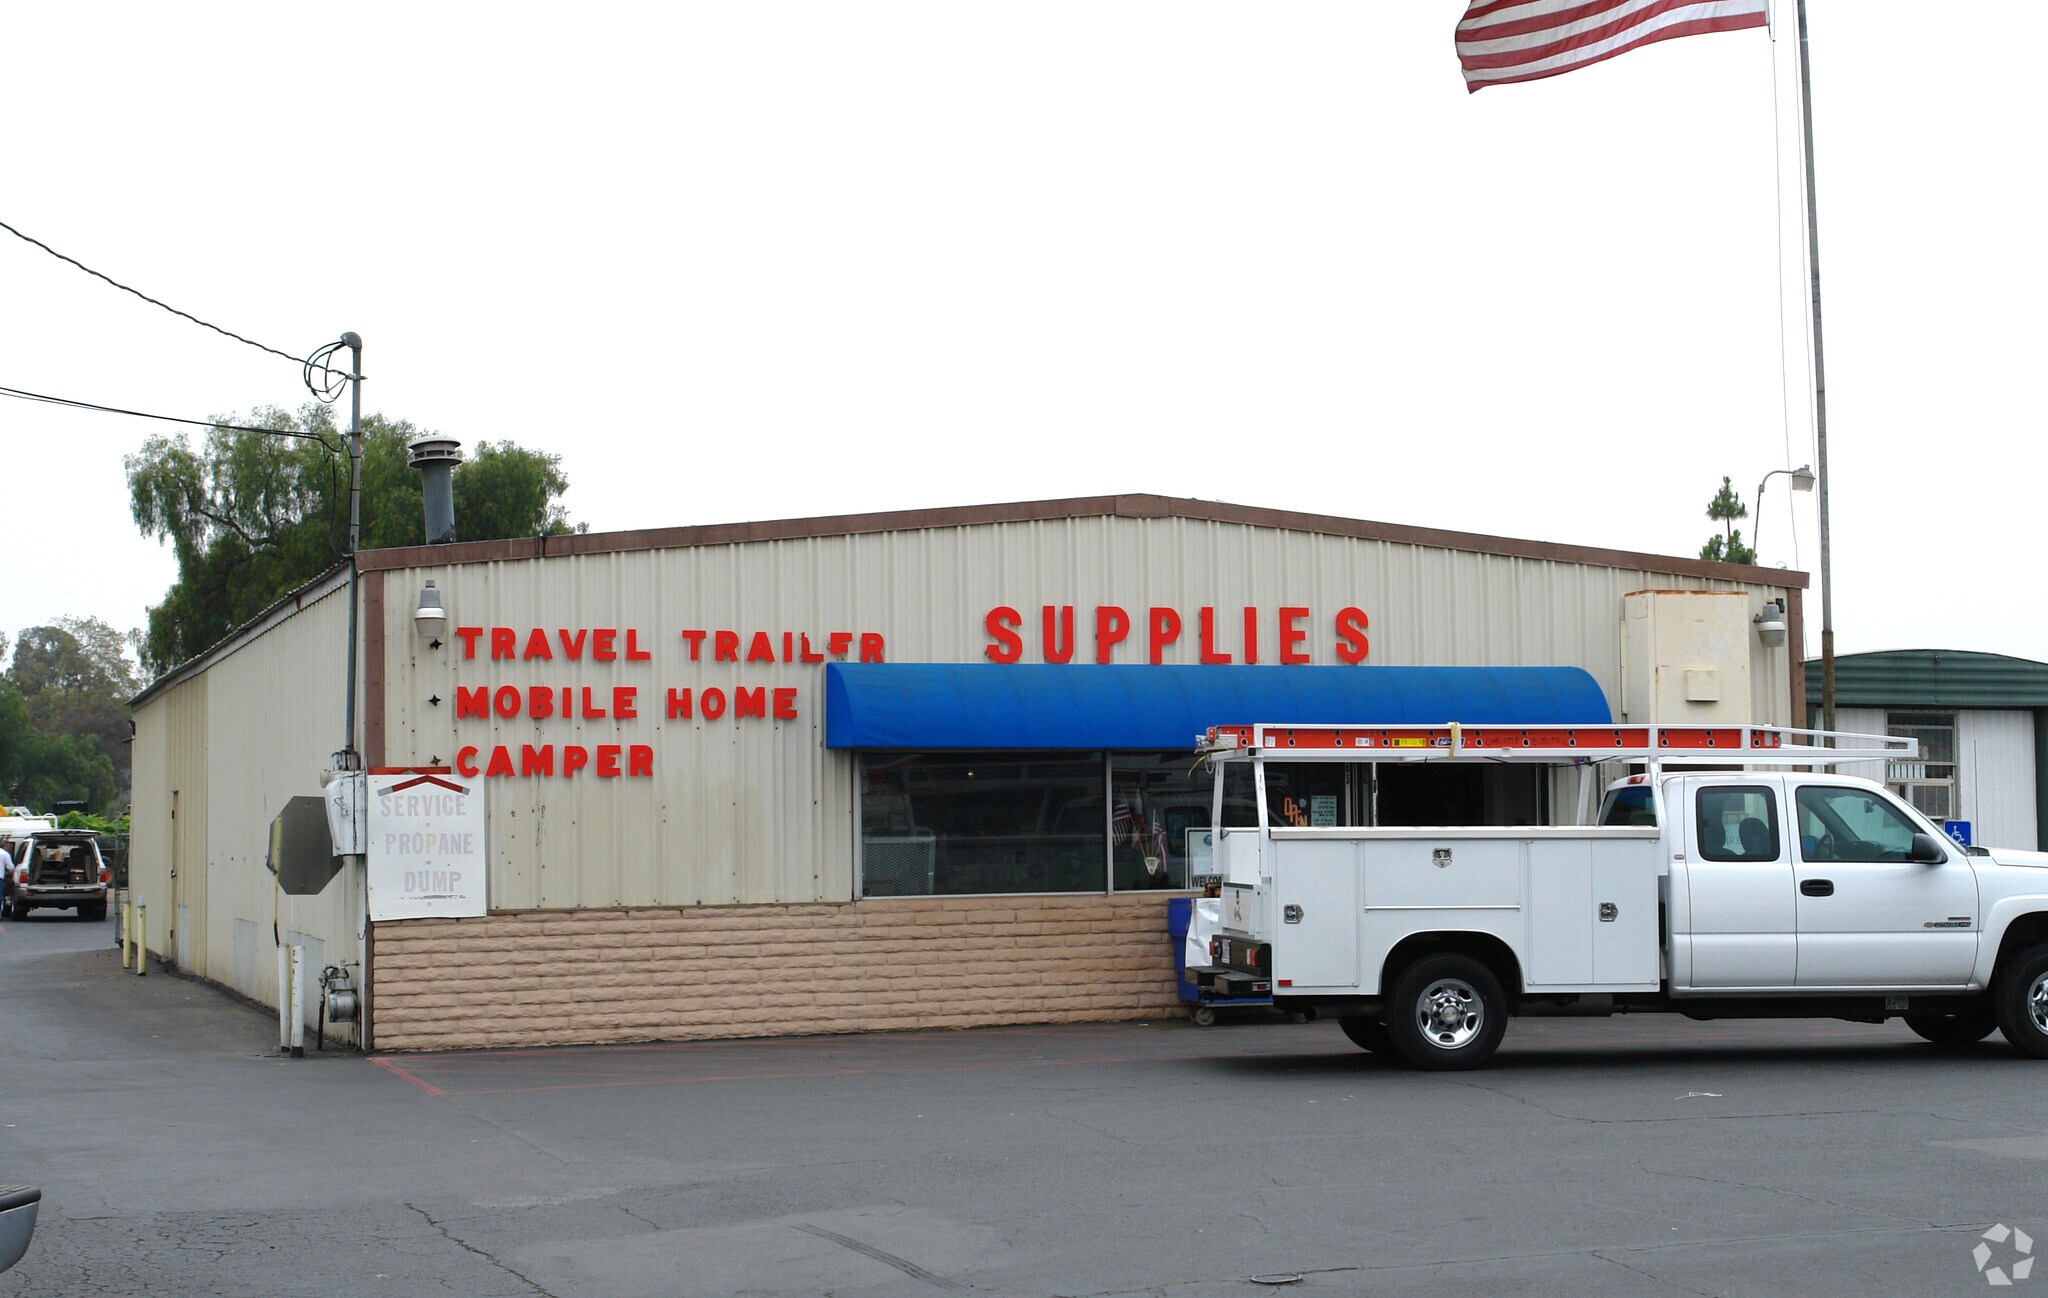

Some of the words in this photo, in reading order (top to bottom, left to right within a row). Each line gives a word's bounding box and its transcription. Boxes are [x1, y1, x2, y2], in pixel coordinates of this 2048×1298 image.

[456, 626, 652, 661] TRAVEL
[985, 604, 1369, 665] SUPPLIES
[456, 685, 638, 720] MOBILE
[667, 686, 798, 720] HOME
[456, 743, 654, 779] CAMPER
[380, 794, 467, 818] SERVICE
[385, 832, 474, 855] PROPANE
[404, 870, 462, 893] DUMP
